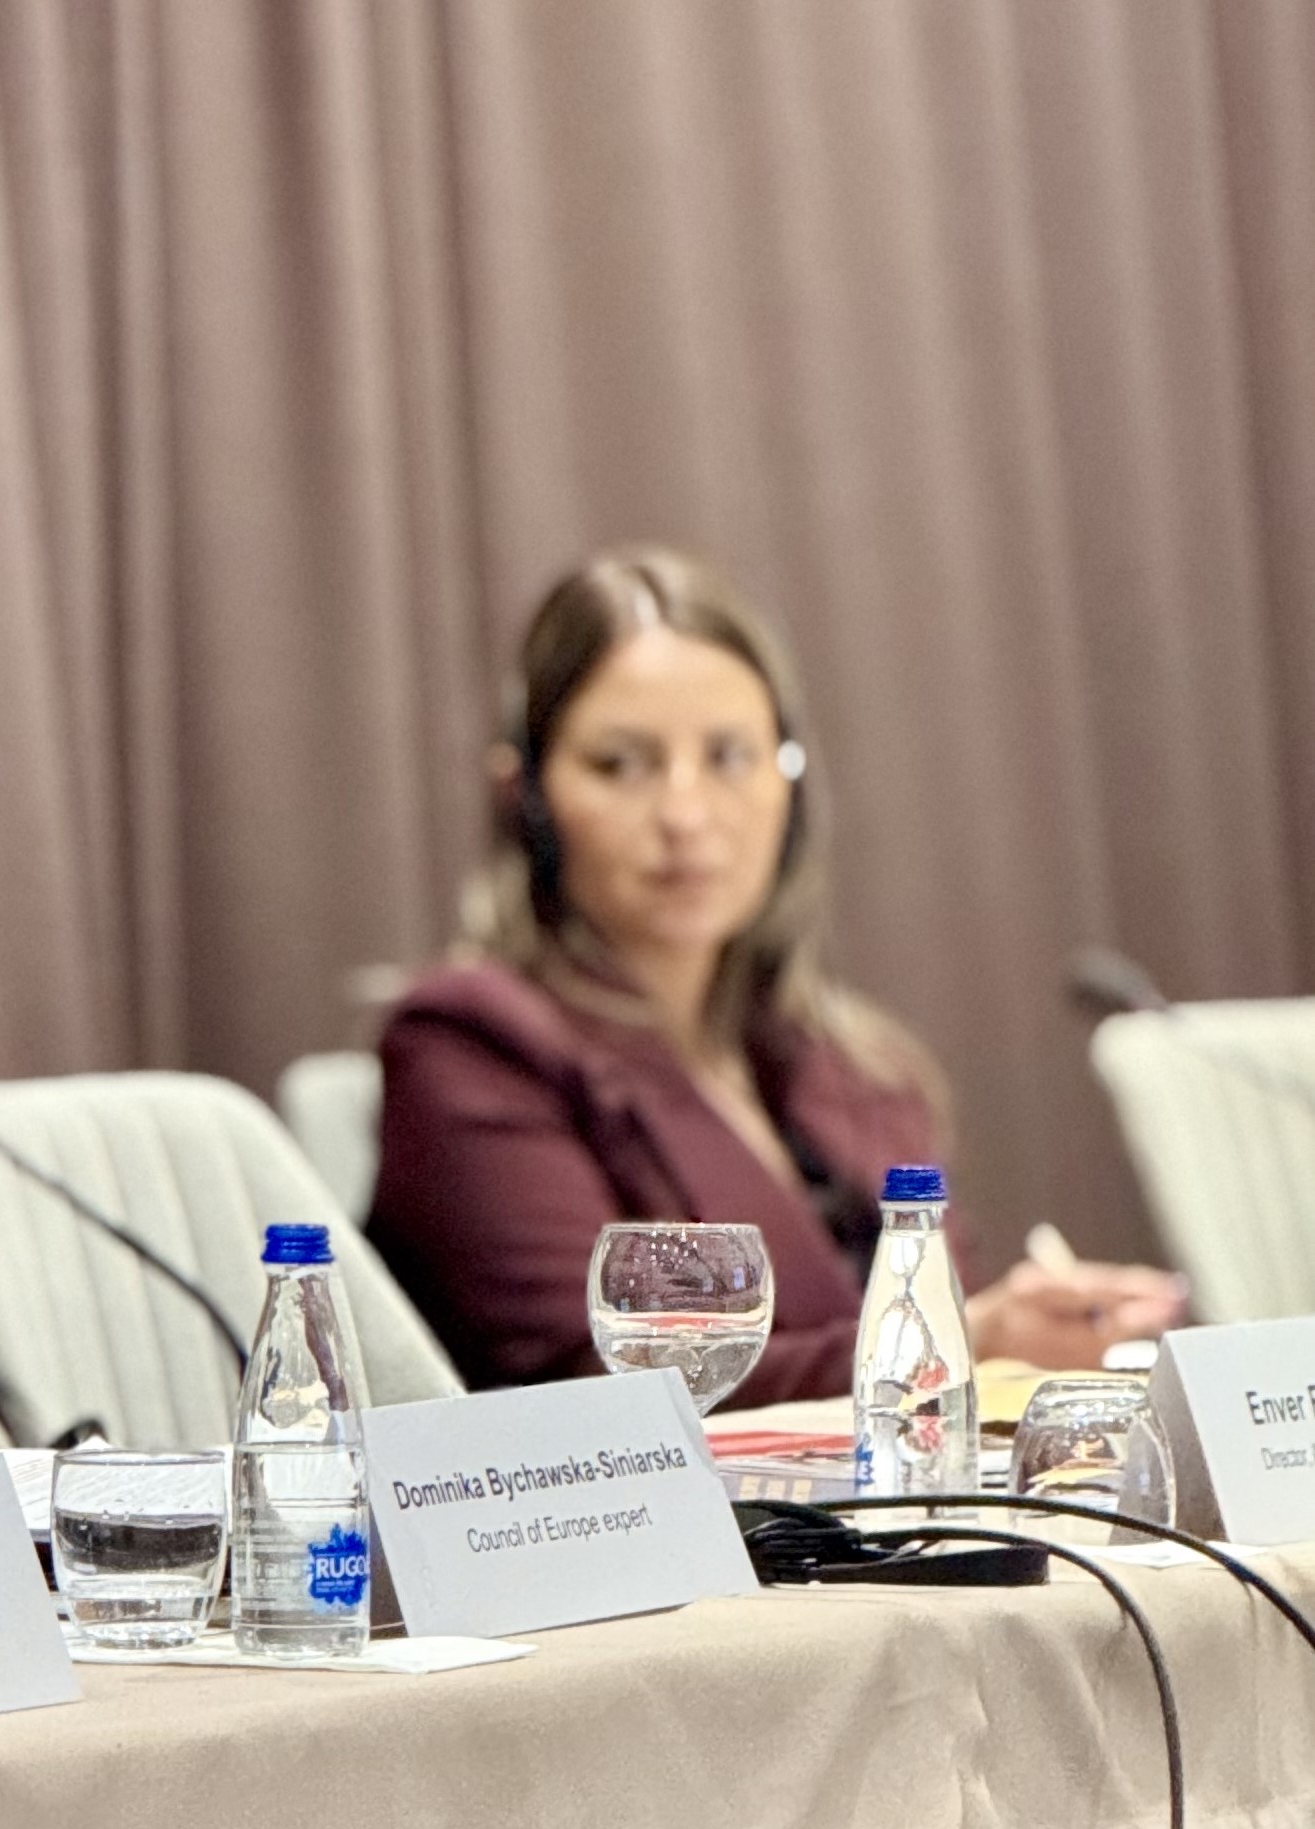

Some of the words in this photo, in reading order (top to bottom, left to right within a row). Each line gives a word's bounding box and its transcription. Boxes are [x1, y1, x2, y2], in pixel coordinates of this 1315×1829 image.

[1245, 1390, 1306, 1425] Enver
[393, 1472, 485, 1510] Dominika
[485, 1442, 687, 1501] Bychawska-Siniarska
[467, 1521, 525, 1553] Council
[527, 1517, 543, 1545] of
[543, 1515, 601, 1543] Europe
[603, 1503, 653, 1536] expert
